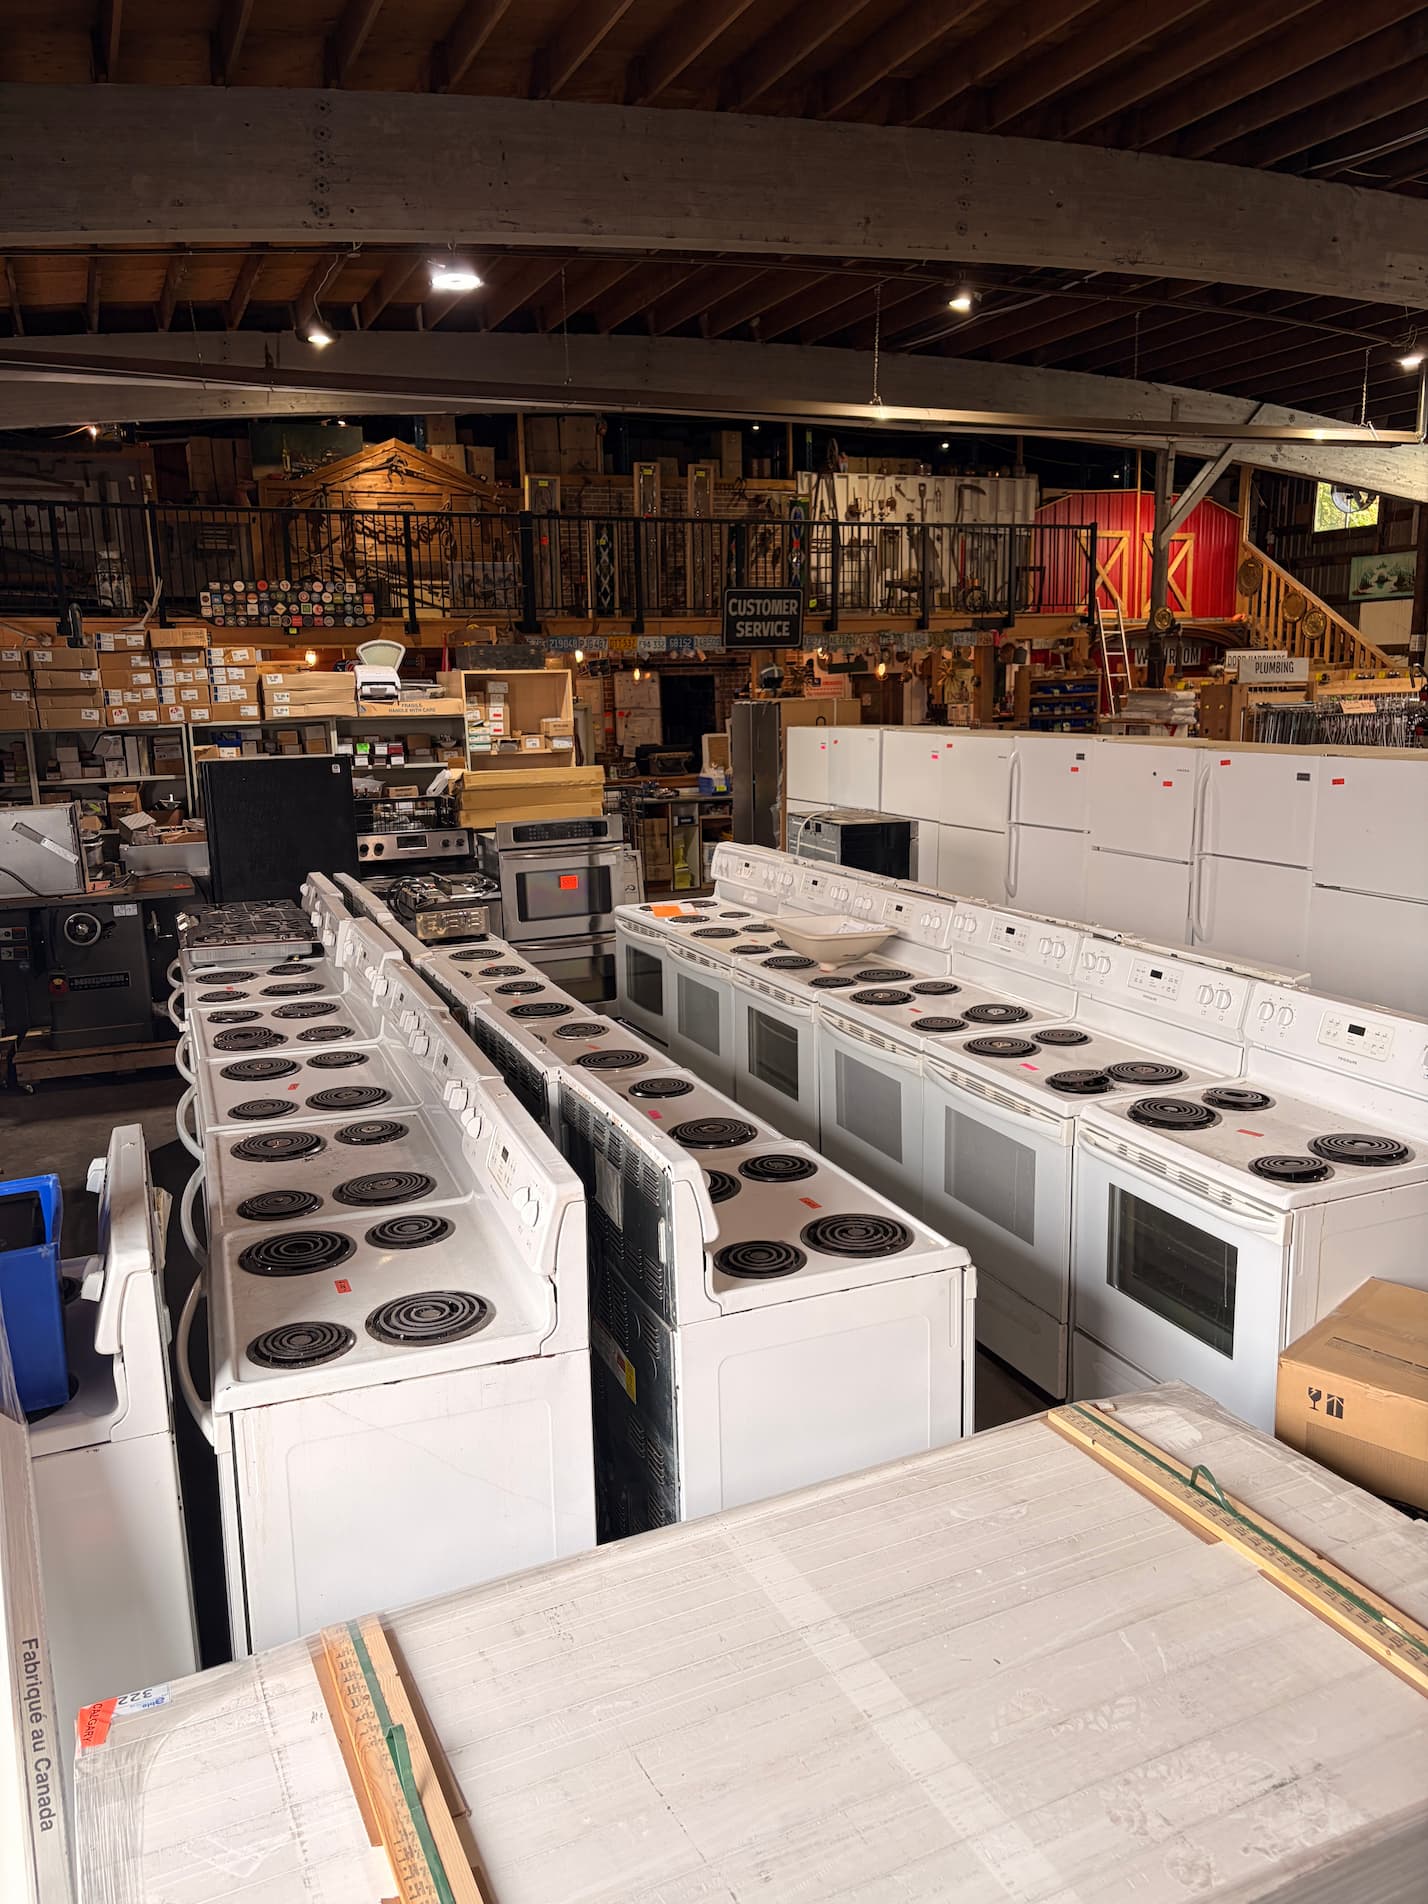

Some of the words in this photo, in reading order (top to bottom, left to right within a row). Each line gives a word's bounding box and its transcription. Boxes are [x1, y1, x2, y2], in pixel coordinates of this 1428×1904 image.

[728, 598, 798, 616] CUSTOMER
[735, 620, 790, 638] SERVICE
[1136, 648, 1199, 664] WROM
[1255, 661, 1294, 674] PLUMBING
[22, 1638, 47, 1724] Fabriqué
[118, 1688, 153, 1706] 322
[83, 1703, 103, 1742] CALGARY
[31, 1728, 46, 1752] au
[34, 1757, 56, 1832] Canada
